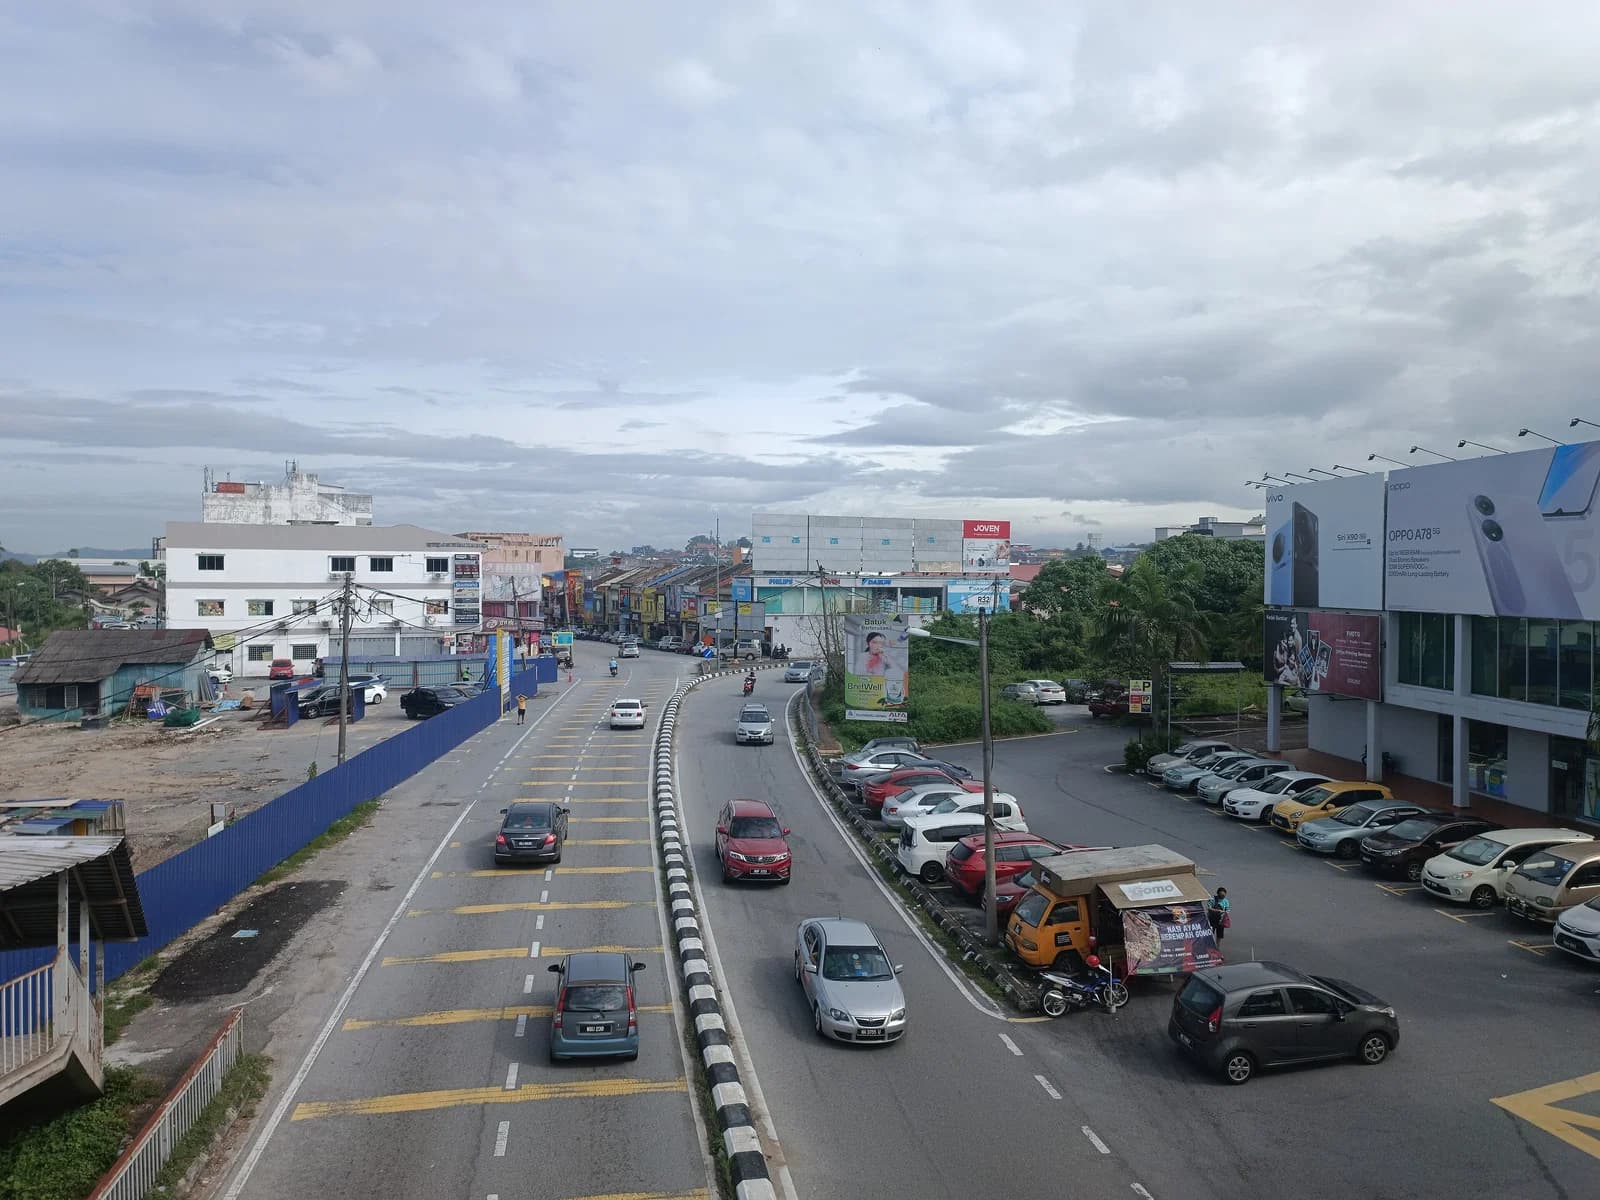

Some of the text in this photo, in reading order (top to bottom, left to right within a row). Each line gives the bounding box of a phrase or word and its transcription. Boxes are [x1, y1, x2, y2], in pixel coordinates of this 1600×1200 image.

[1390, 482, 1411, 491] oppo
[1266, 494, 1284, 503] vivo
[1389, 529, 1413, 541] OPPO
[1415, 528, 1432, 540] A78
[864, 618, 887, 626] Batuk
[1142, 681, 1151, 692] P
[1167, 923, 1202, 933] NASI AYAM
[1161, 928, 1212, 940] BEREMPAH GOMO
